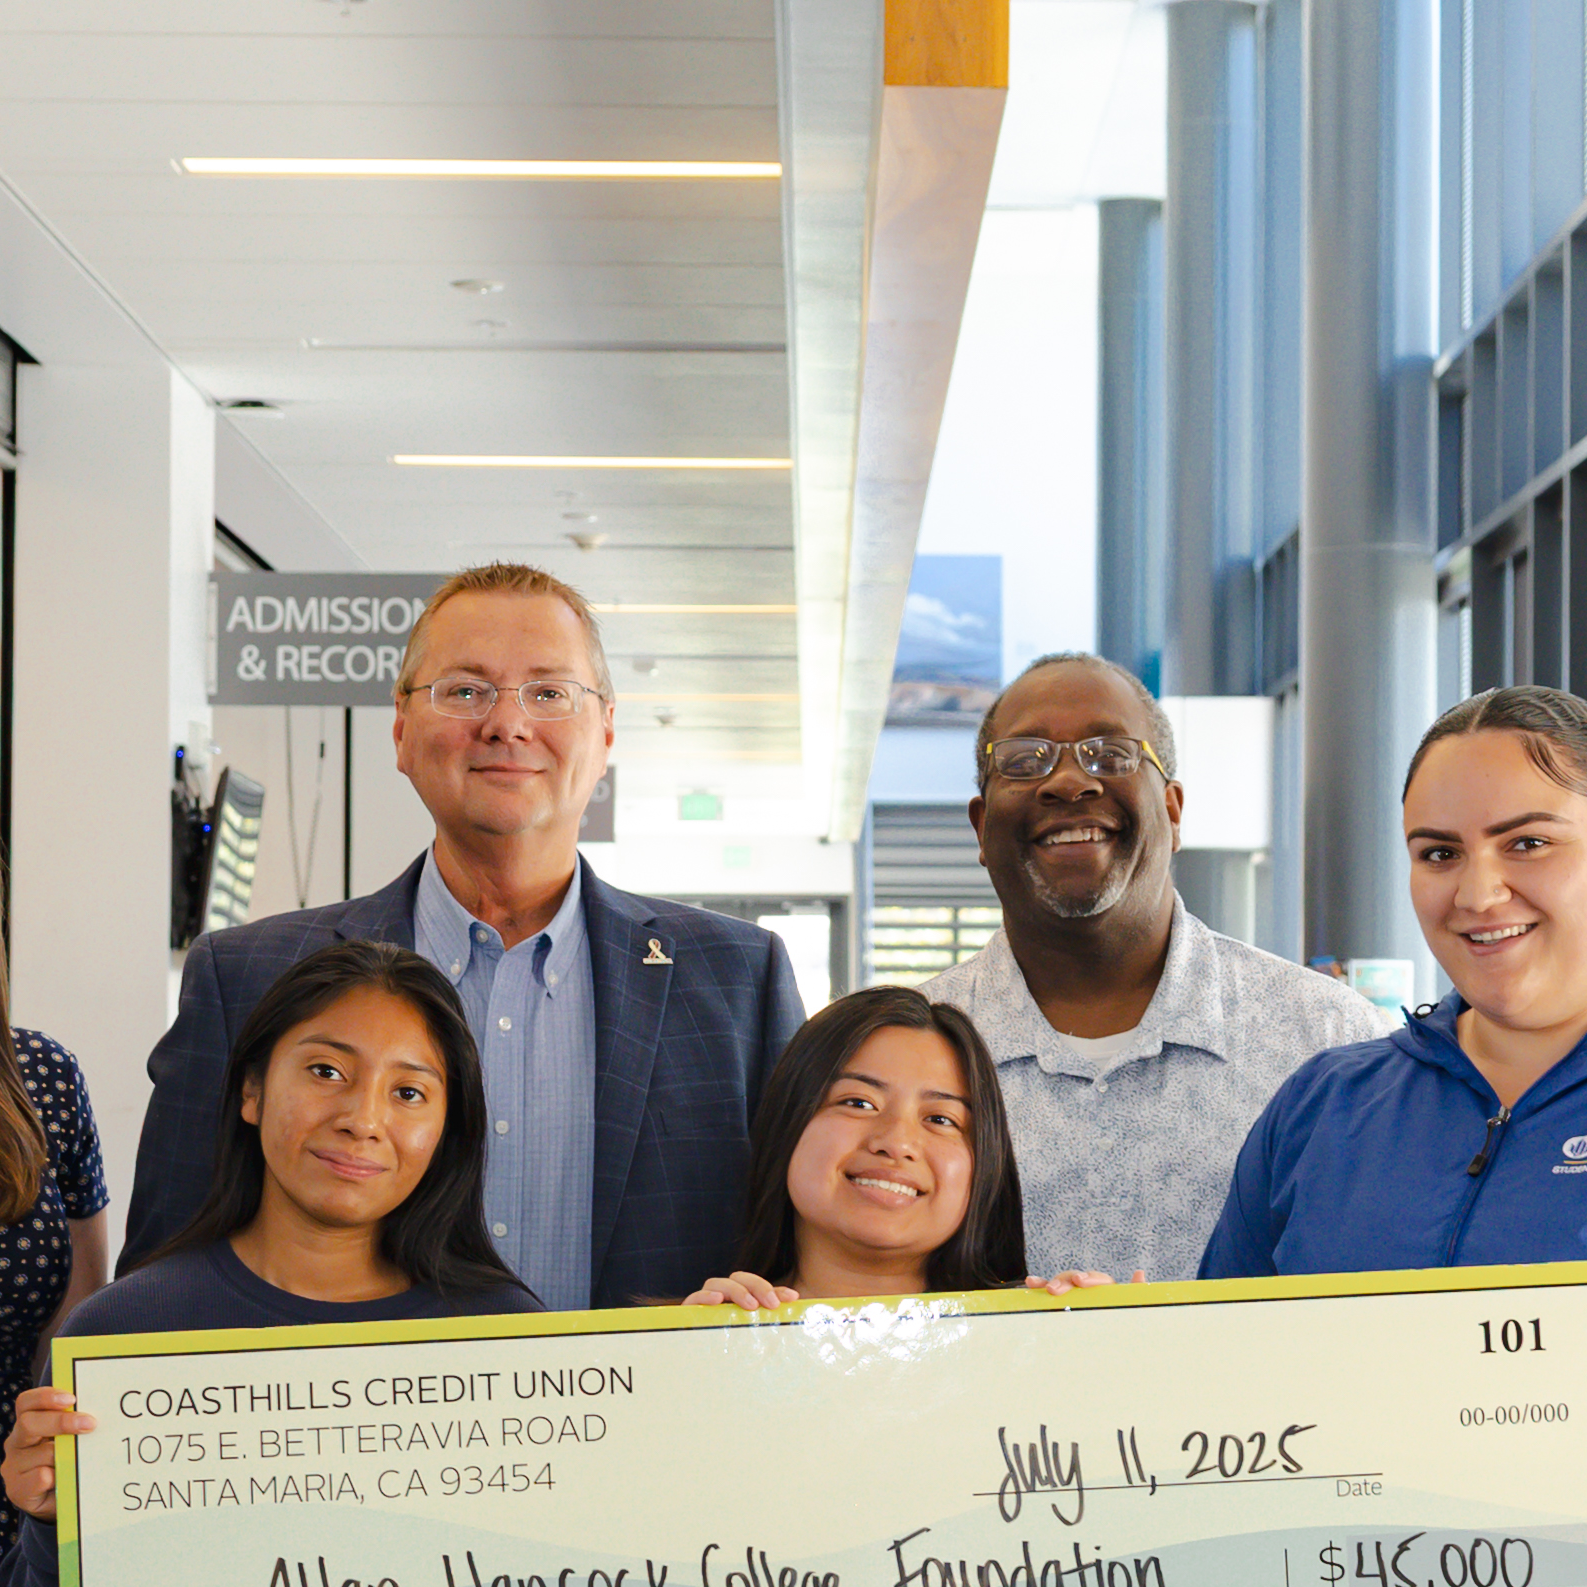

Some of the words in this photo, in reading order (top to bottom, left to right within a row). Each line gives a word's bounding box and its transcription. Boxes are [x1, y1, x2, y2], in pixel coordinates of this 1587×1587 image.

[236, 644, 267, 682] &
[276, 644, 407, 682] RECOR
[1478, 1317, 1547, 1354] 101
[119, 1379, 352, 1419] COASTHILLS
[363, 1372, 500, 1407] CREDIT
[513, 1366, 634, 1400] UNION
[1459, 1403, 1570, 1428] 00-00/000
[121, 1432, 206, 1464] 1075
[218, 1430, 247, 1460] E.
[260, 1420, 490, 1458] BETTERAVIA
[501, 1414, 607, 1448] ROAD
[1181, 1424, 1317, 1481] 2025
[122, 1478, 240, 1512] SANTA
[249, 1472, 365, 1506] MARIA,
[377, 1469, 428, 1500] CA
[440, 1462, 556, 1496] 93454
[1335, 1478, 1383, 1498] Date
